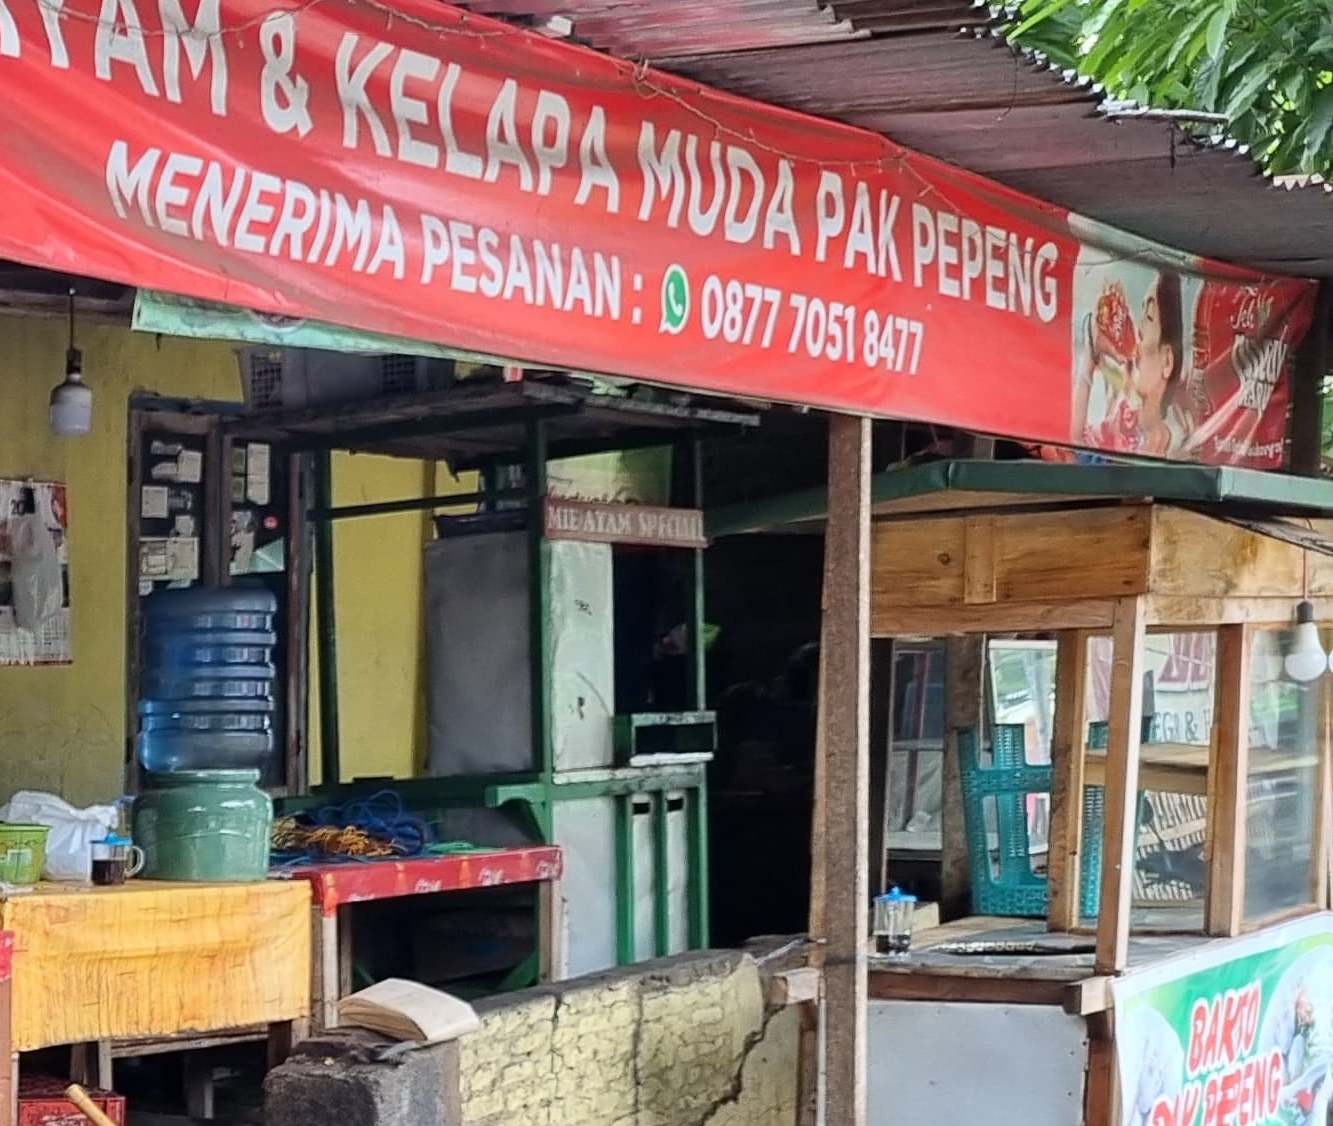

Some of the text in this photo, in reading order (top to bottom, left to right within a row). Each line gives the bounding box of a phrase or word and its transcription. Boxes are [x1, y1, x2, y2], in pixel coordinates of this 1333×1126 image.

[105, 140, 405, 280] MENERIMA
[420, 214, 622, 320] PESANAN
[701, 275, 781, 348] 0877
[789, 295, 855, 364] 7051
[864, 309, 924, 376] 8477
[259, 10, 314, 138] &
[335, 32, 621, 214] KELAPA
[636, 127, 801, 256] MUDA
[815, 171, 903, 283] PAK
[913, 203, 1060, 323] PEPENG
[548, 504, 579, 530] MIE
